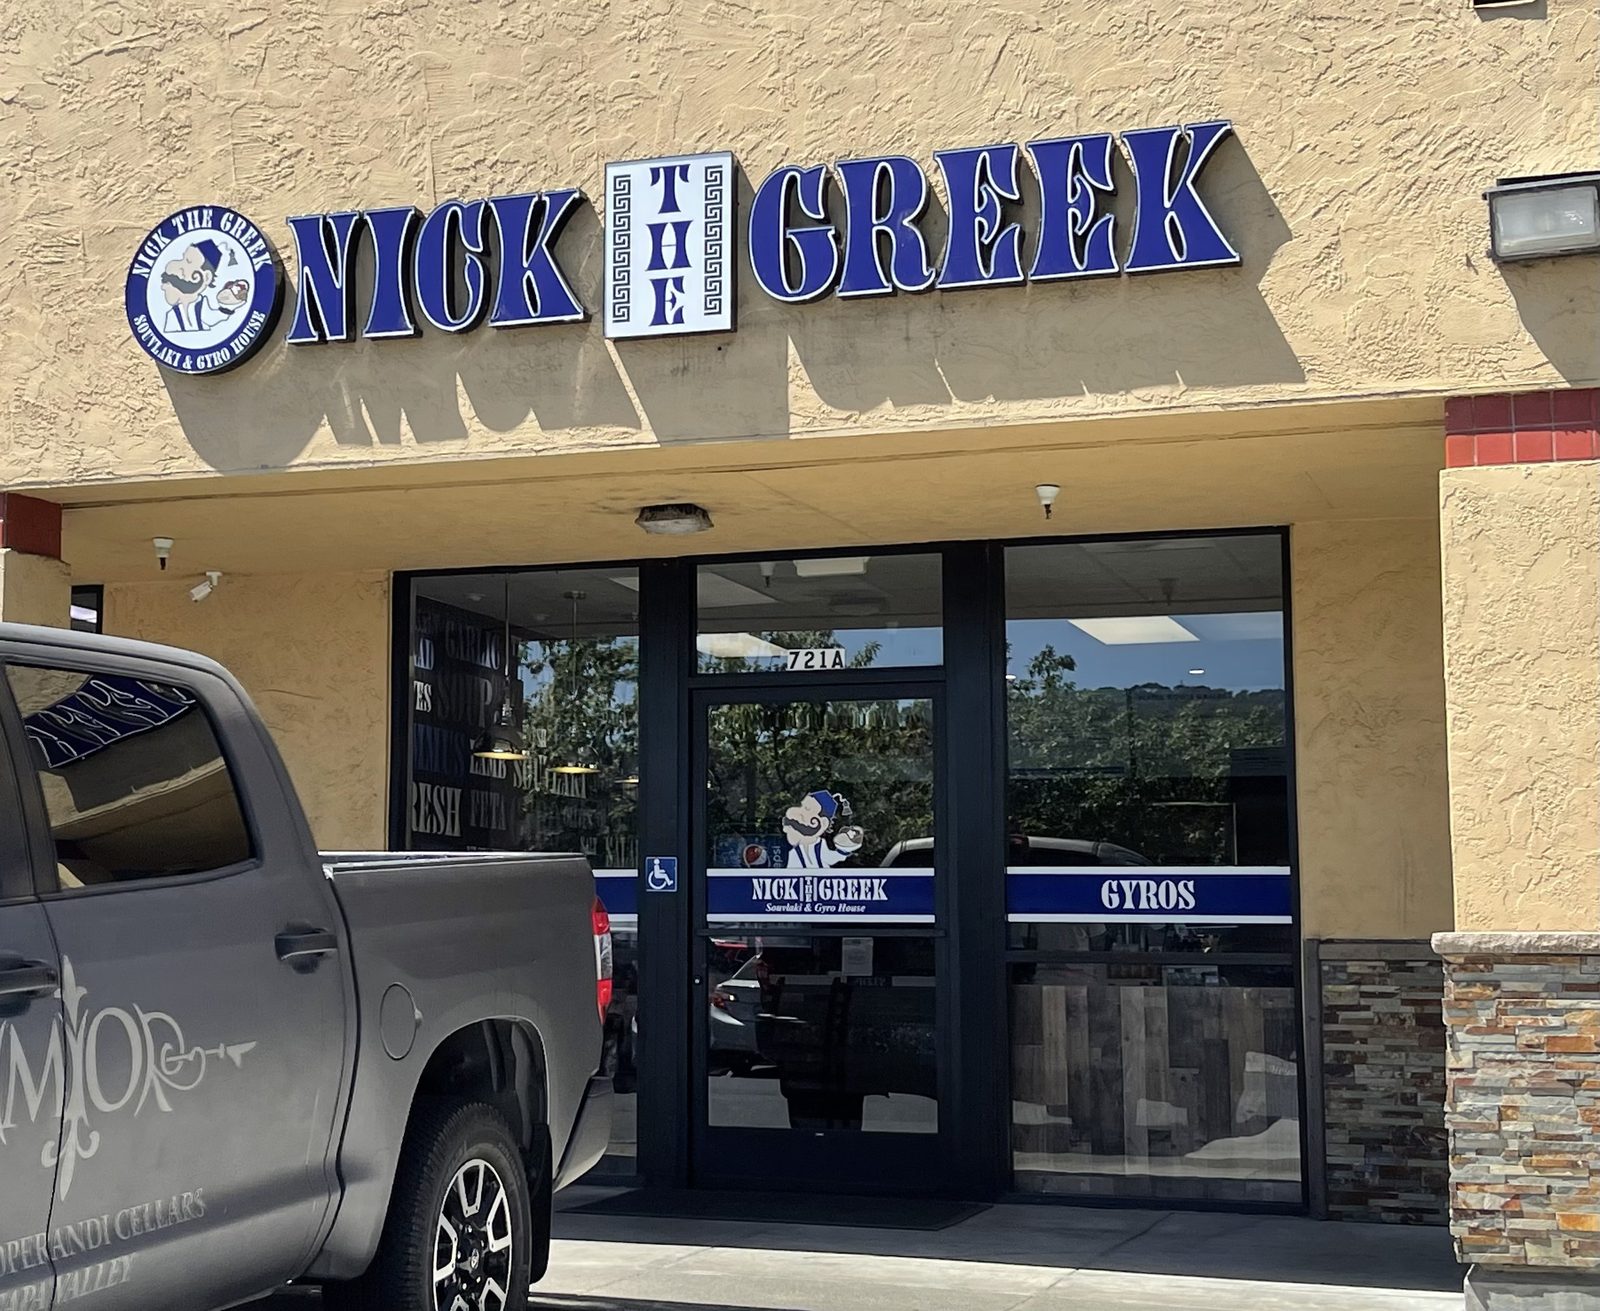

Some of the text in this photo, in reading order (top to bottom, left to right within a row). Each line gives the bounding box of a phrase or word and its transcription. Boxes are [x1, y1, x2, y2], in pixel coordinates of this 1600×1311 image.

[132, 209, 272, 279] NICK THE GREEK
[286, 120, 1241, 344] NICK THE GREEK
[133, 310, 267, 370] SOUVLAKI & GYRO HOUSE
[789, 650, 844, 669] 721A
[752, 878, 798, 900] NICK
[818, 878, 888, 901] GREEK
[765, 902, 866, 914] Souvlaki & Gyro House
[1101, 880, 1196, 910] GYROS
[114, 1187, 206, 1240] CELLARS
[56, 1252, 138, 1304] VALLEY
